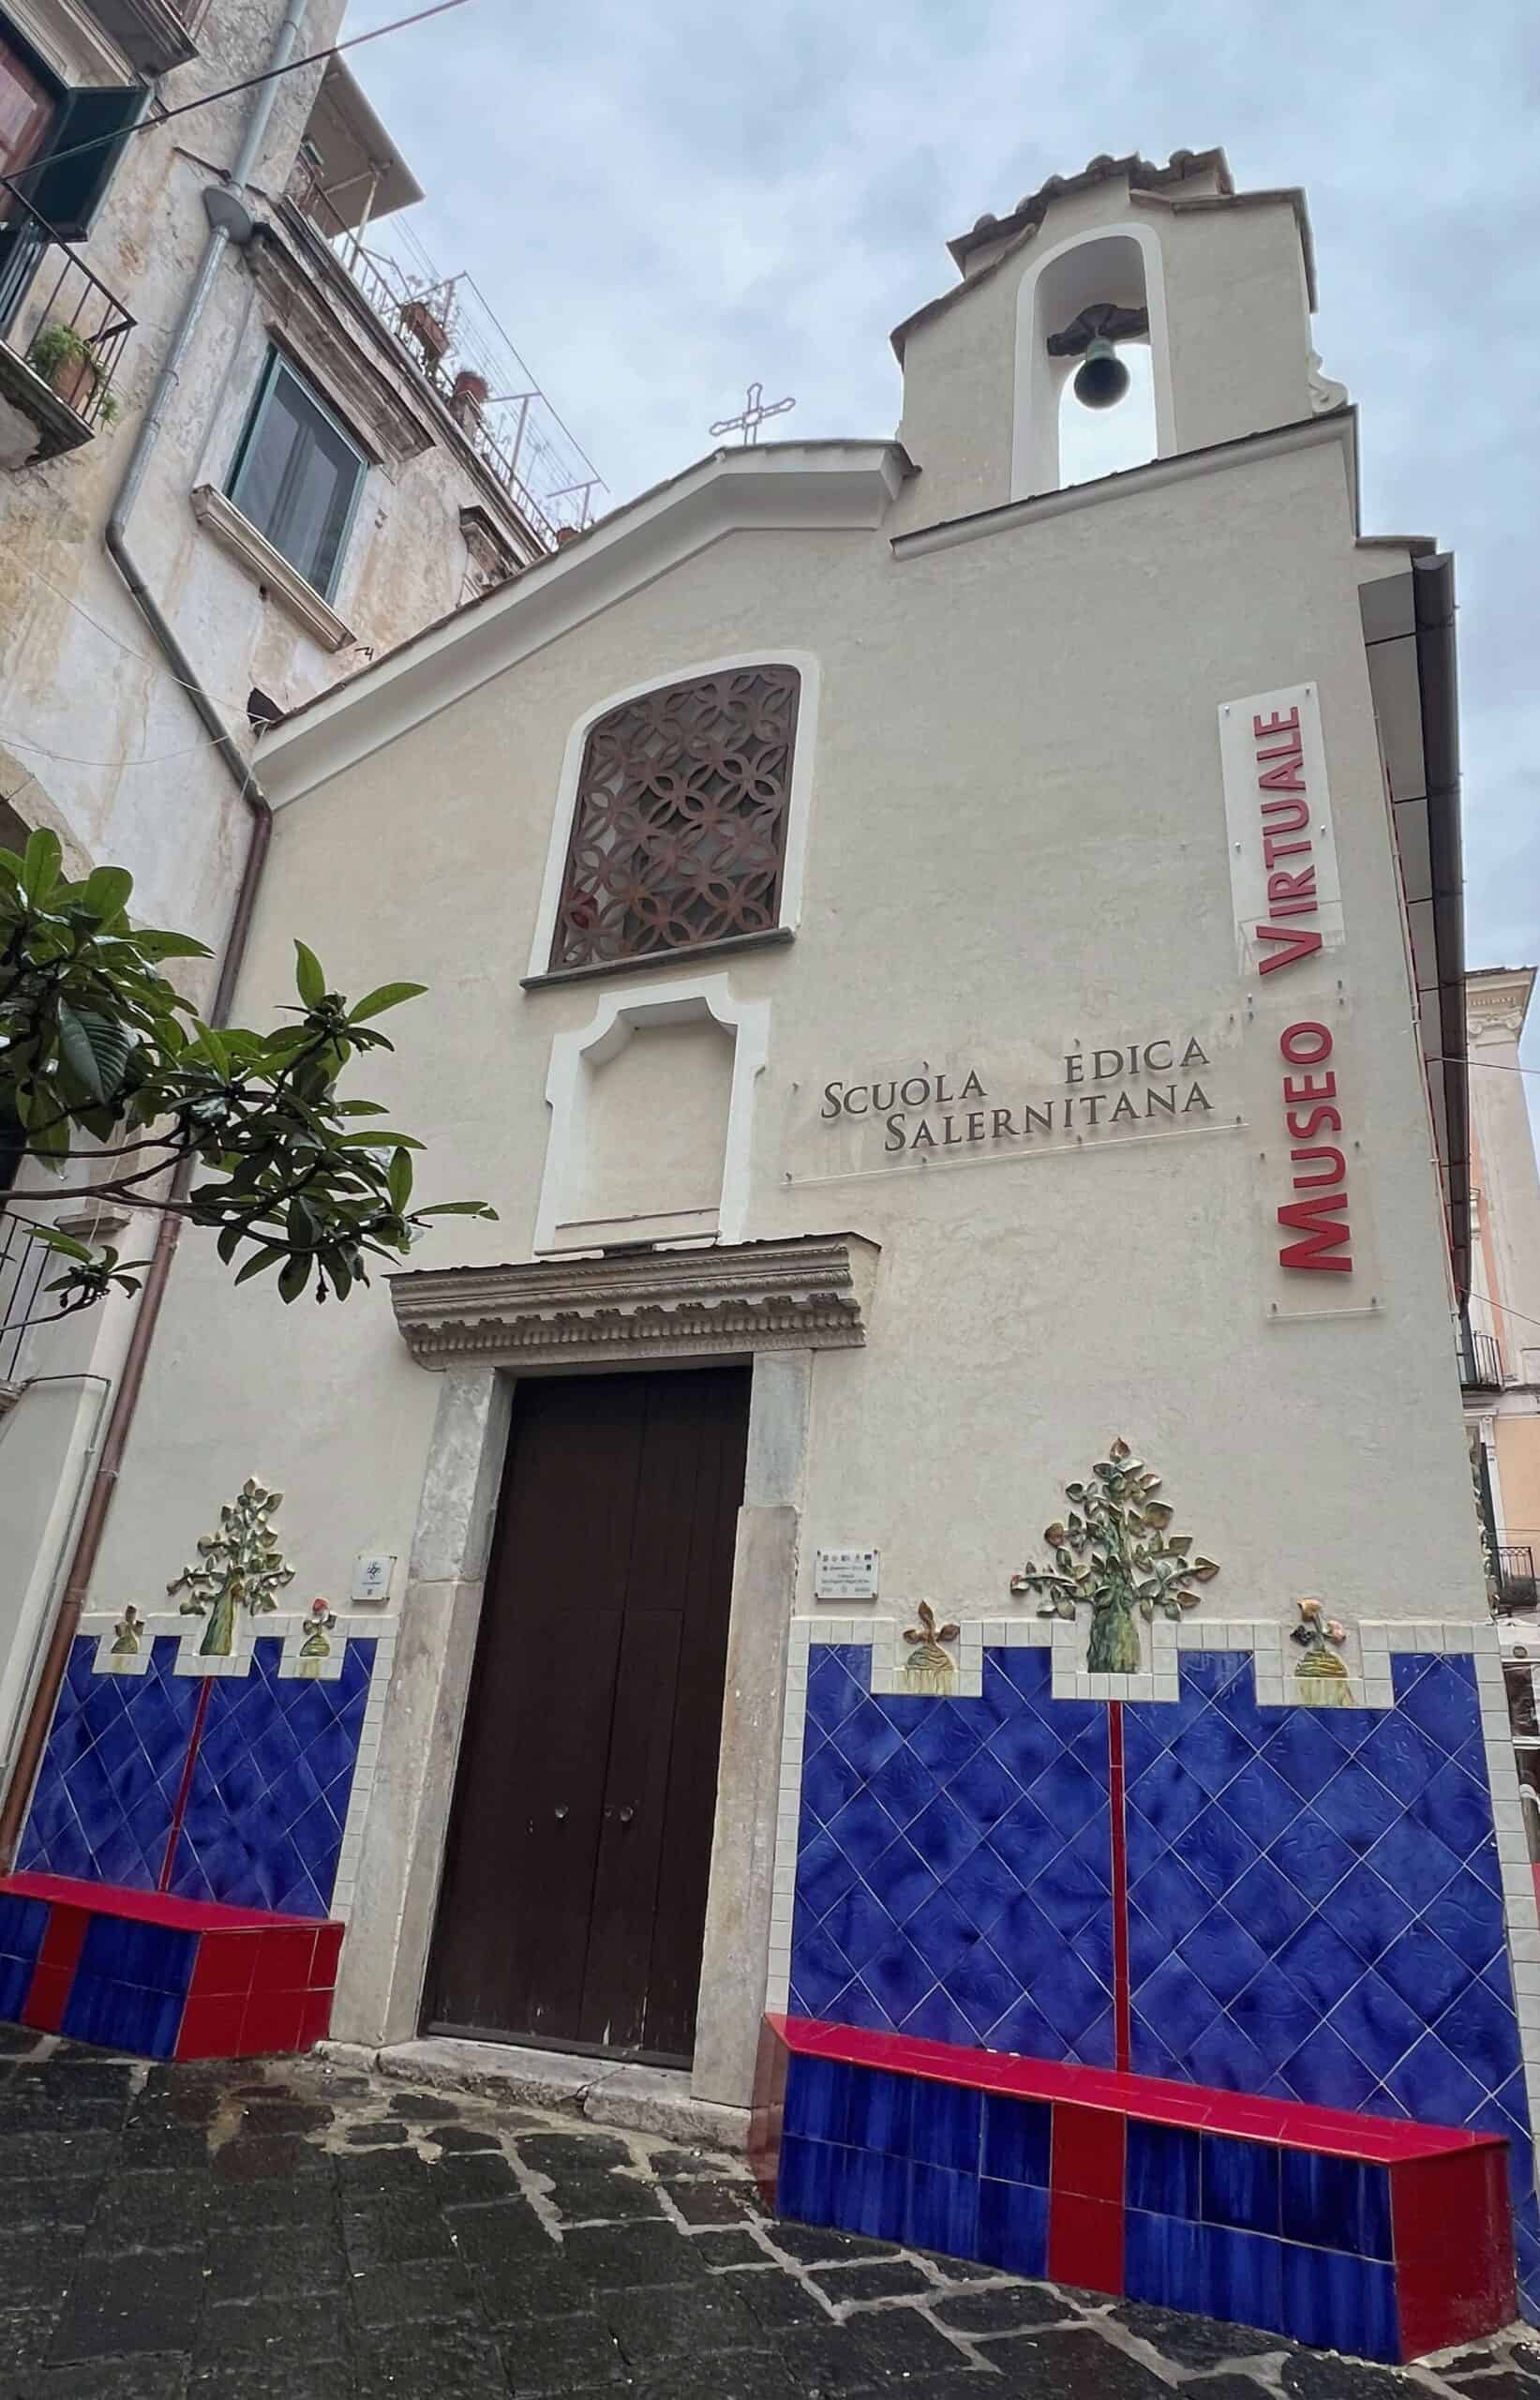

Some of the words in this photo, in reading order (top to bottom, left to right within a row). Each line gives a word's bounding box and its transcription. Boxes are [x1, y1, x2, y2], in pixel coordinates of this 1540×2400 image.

[1254, 706, 1323, 976] VIRTUALE
[820, 1070, 988, 1118] SCUOLA
[884, 1082, 1215, 1151] SALERNITANA
[1277, 1021, 1353, 1272] MUSEO
